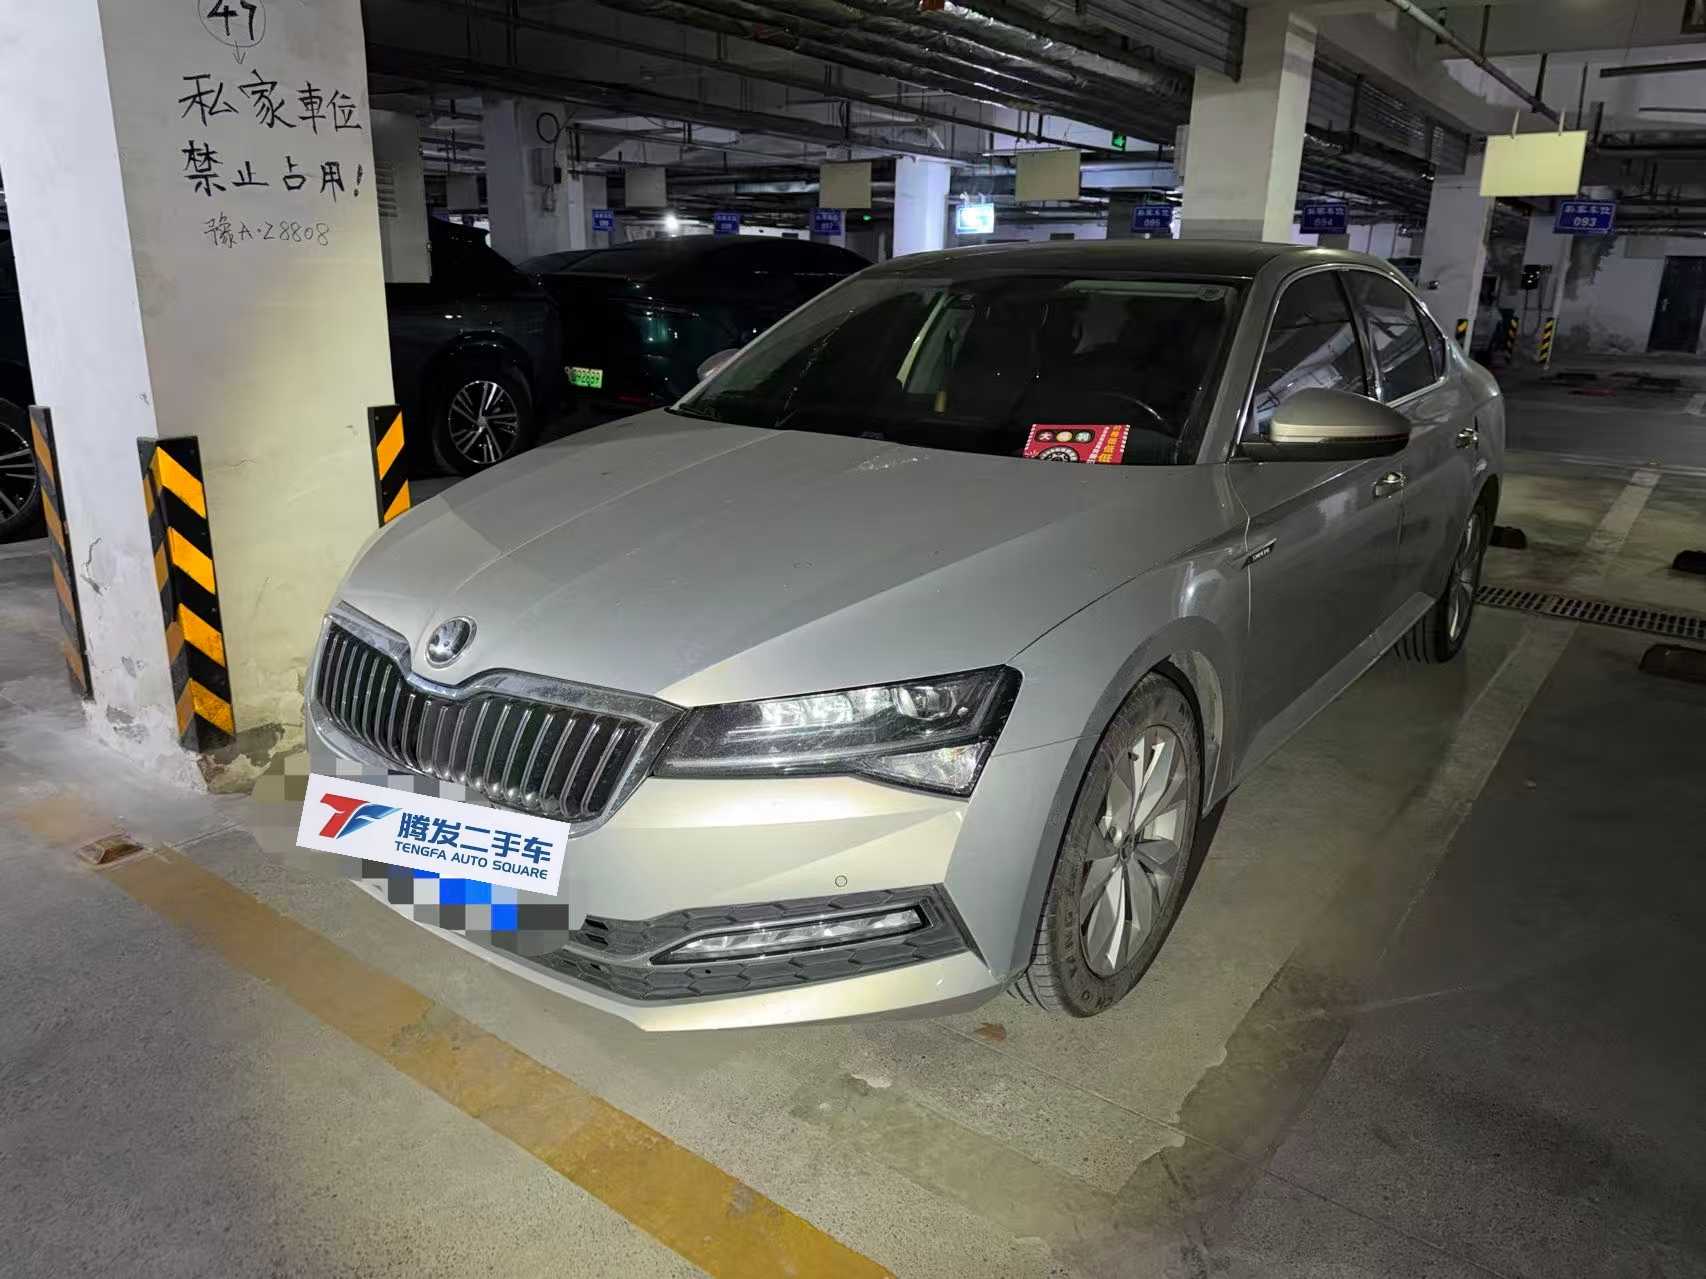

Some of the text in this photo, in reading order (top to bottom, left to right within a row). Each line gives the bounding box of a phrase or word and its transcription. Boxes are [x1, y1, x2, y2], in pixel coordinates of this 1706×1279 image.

[178, 69, 362, 134] 私家車位
[1573, 216, 1597, 227] 093
